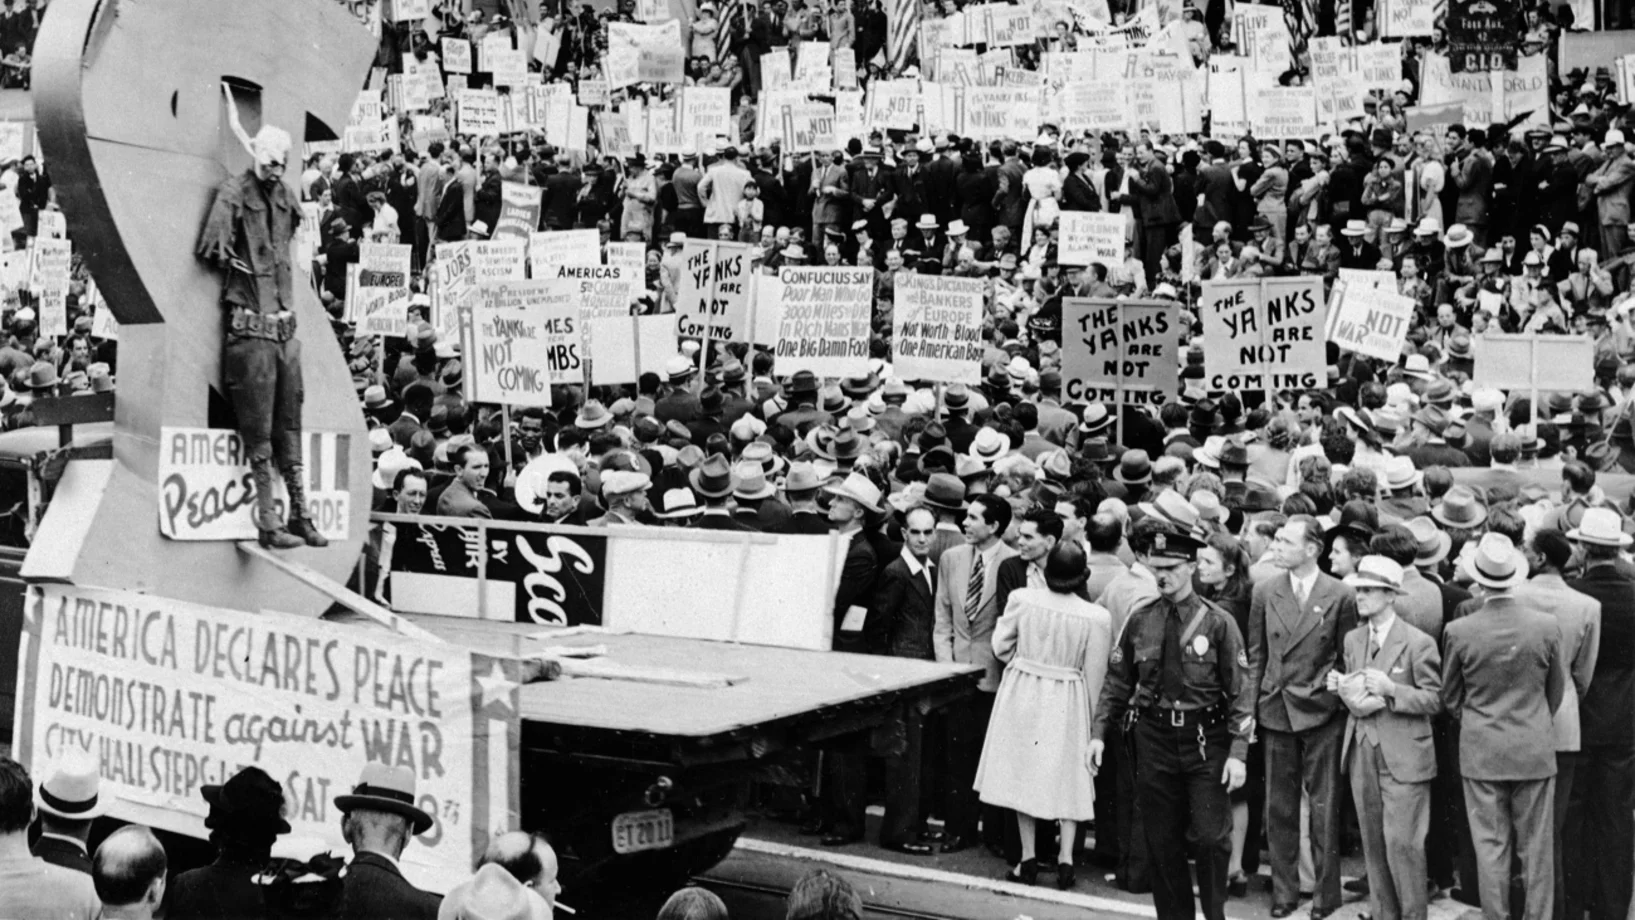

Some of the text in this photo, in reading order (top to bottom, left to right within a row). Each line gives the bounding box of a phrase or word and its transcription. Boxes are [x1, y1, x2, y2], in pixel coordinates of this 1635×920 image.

[810, 118, 832, 134] NOT
[797, 130, 815, 146] WAR
[688, 249, 709, 271] THE
[1097, 247, 1117, 257] WAR
[444, 248, 471, 286] JOBS
[482, 268, 512, 276] ASCISM
[558, 265, 620, 279] AMERICAS
[693, 254, 742, 290] YANKS
[781, 268, 871, 285] CONFUCIUS SAY
[811, 285, 833, 301] Man
[920, 290, 973, 309] BANKERS
[1213, 290, 1245, 313] THE
[699, 298, 729, 315] NOT
[783, 304, 811, 320] 3000
[924, 306, 973, 325] EUROPE
[1222, 289, 1315, 339] YANKS
[493, 314, 524, 338] YANKS
[1078, 305, 1117, 333] THE
[1366, 308, 1405, 338] NOT
[900, 321, 982, 342] Not Worth Blood
[1082, 311, 1168, 355] YANKS
[1273, 326, 1313, 342] ARE
[1337, 319, 1370, 344] WAR
[483, 338, 513, 375] NOT
[777, 338, 798, 358] One
[818, 338, 847, 358] Damn
[848, 338, 870, 358] Fool
[900, 338, 918, 357] One
[918, 339, 966, 360] American
[1128, 343, 1163, 357] ARE
[1240, 344, 1291, 365] NOT
[498, 365, 544, 393] COMING
[1103, 360, 1150, 378] NOT
[1211, 372, 1317, 389] COMING
[1066, 379, 1167, 405] COMING
[163, 473, 258, 535] Peace
[491, 539, 509, 564] BY
[54, 594, 444, 720] AMERICA DECLARES PEACE
[48, 662, 446, 781] DEMONSTRATE against WAR
[45, 720, 93, 759] CITY
[98, 734, 147, 789] HALL
[285, 769, 331, 823] SAT
